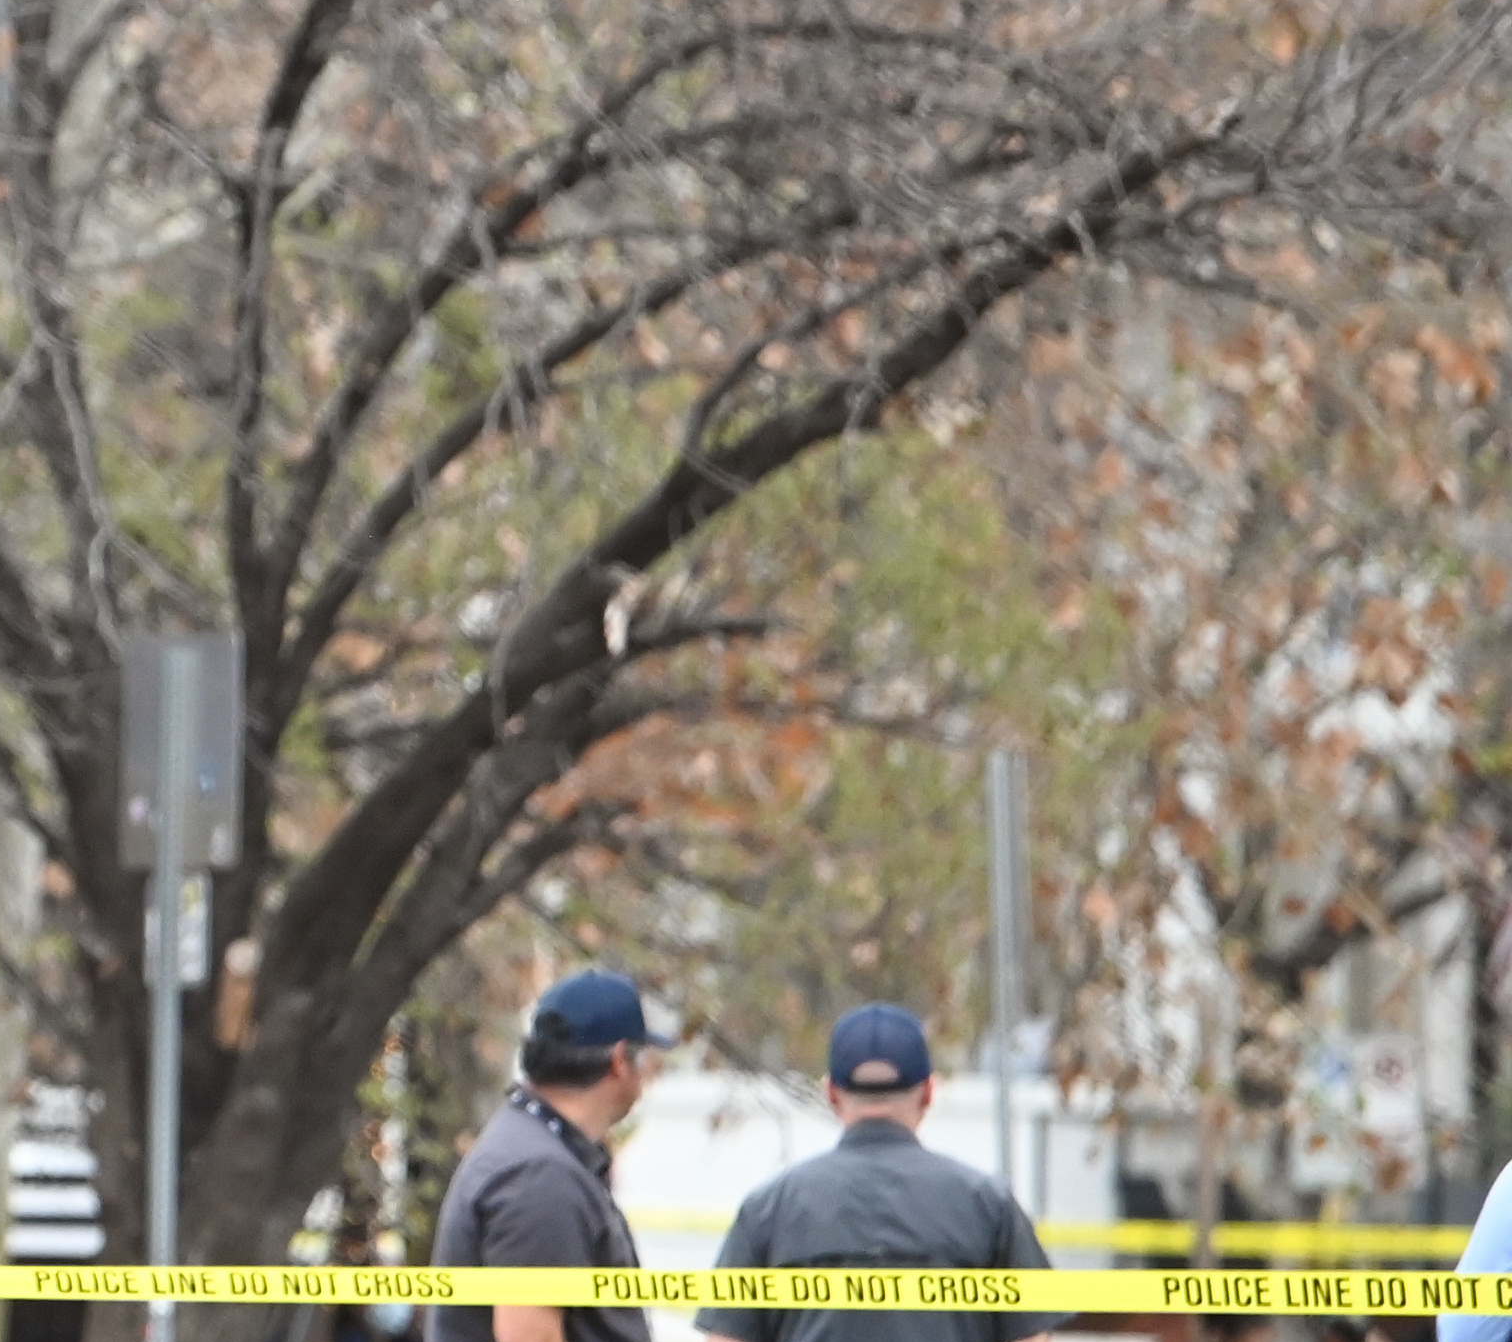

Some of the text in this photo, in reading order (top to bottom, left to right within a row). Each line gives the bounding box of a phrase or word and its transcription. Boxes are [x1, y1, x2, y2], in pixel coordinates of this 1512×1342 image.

[34, 1270, 455, 1298] POLICE LINE DO NOT CROSS
[593, 1273, 1022, 1305] POLICE LINE DO NOT CROSS
[1163, 1276, 1271, 1307] POLICE
[1284, 1276, 1353, 1308] LINE
[1365, 1277, 1408, 1309] DO
[1421, 1277, 1481, 1309] NOT
